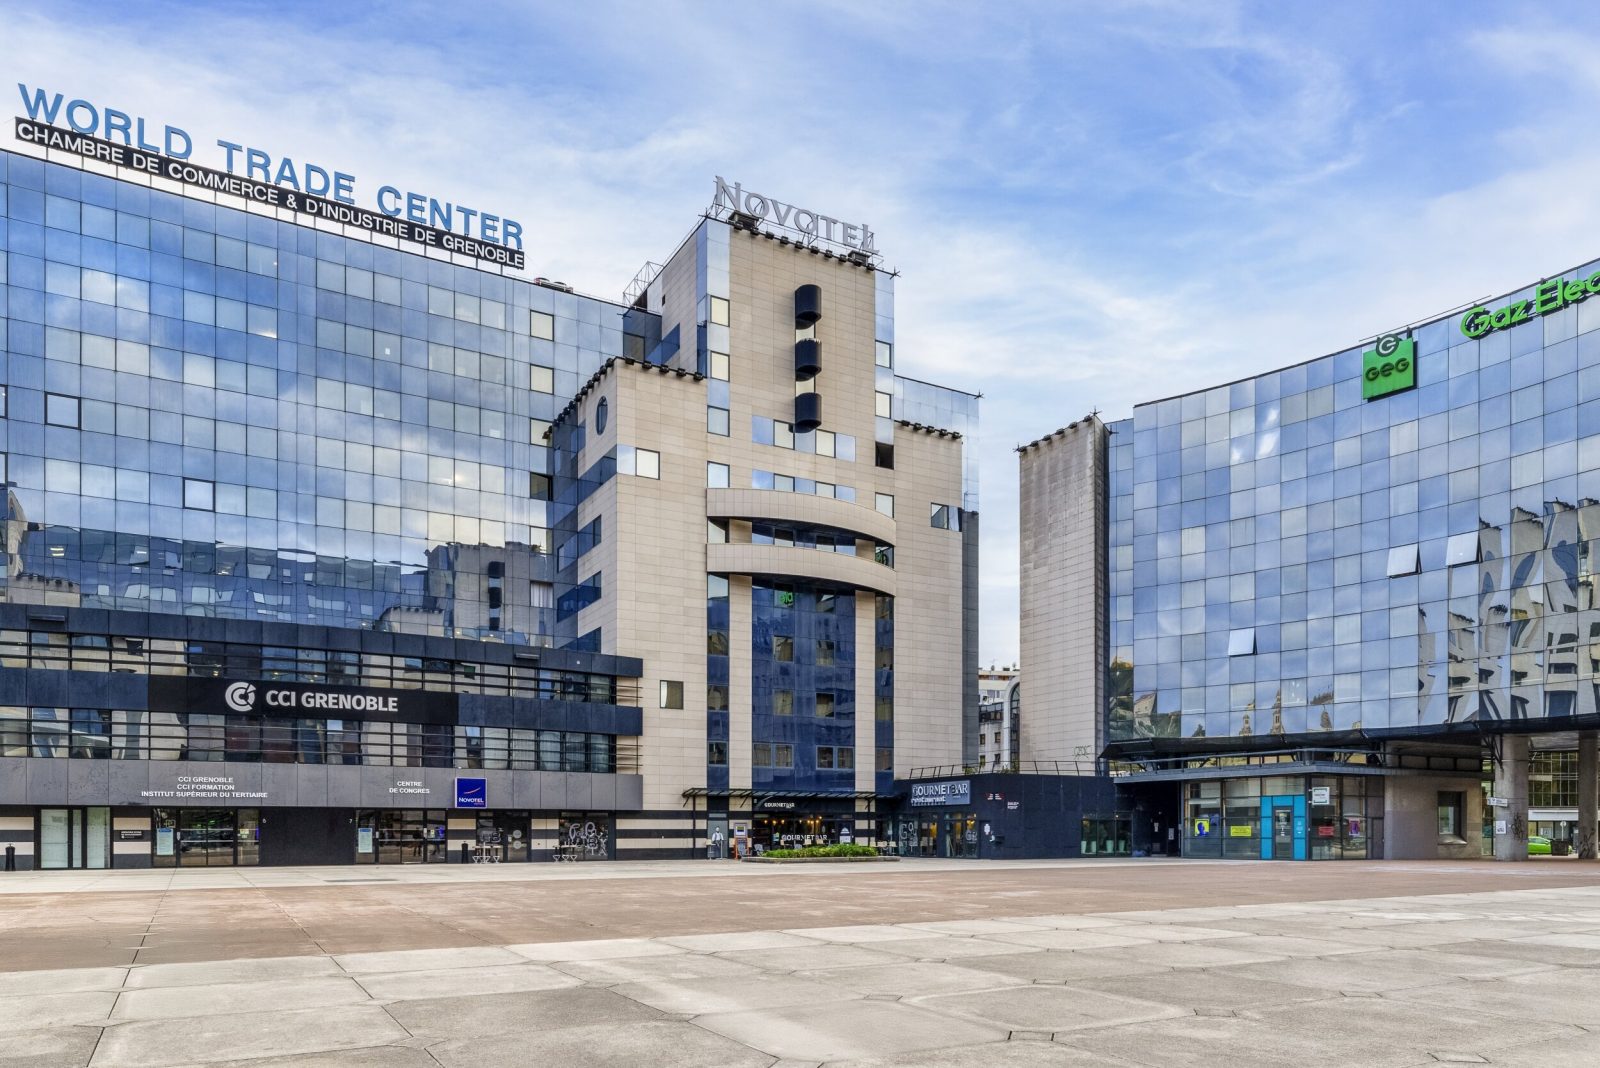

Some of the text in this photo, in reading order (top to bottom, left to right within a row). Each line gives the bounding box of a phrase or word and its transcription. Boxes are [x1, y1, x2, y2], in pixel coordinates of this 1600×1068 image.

[17, 122, 524, 268] CHAMBRE DE COMMERCE & D'INDUSTRIE DE GRENOBLE
[18, 83, 523, 250] WORLD TRADE CENTER
[1460, 299, 1528, 338] Gaz
[265, 689, 399, 712] CCI GRENOBLE
